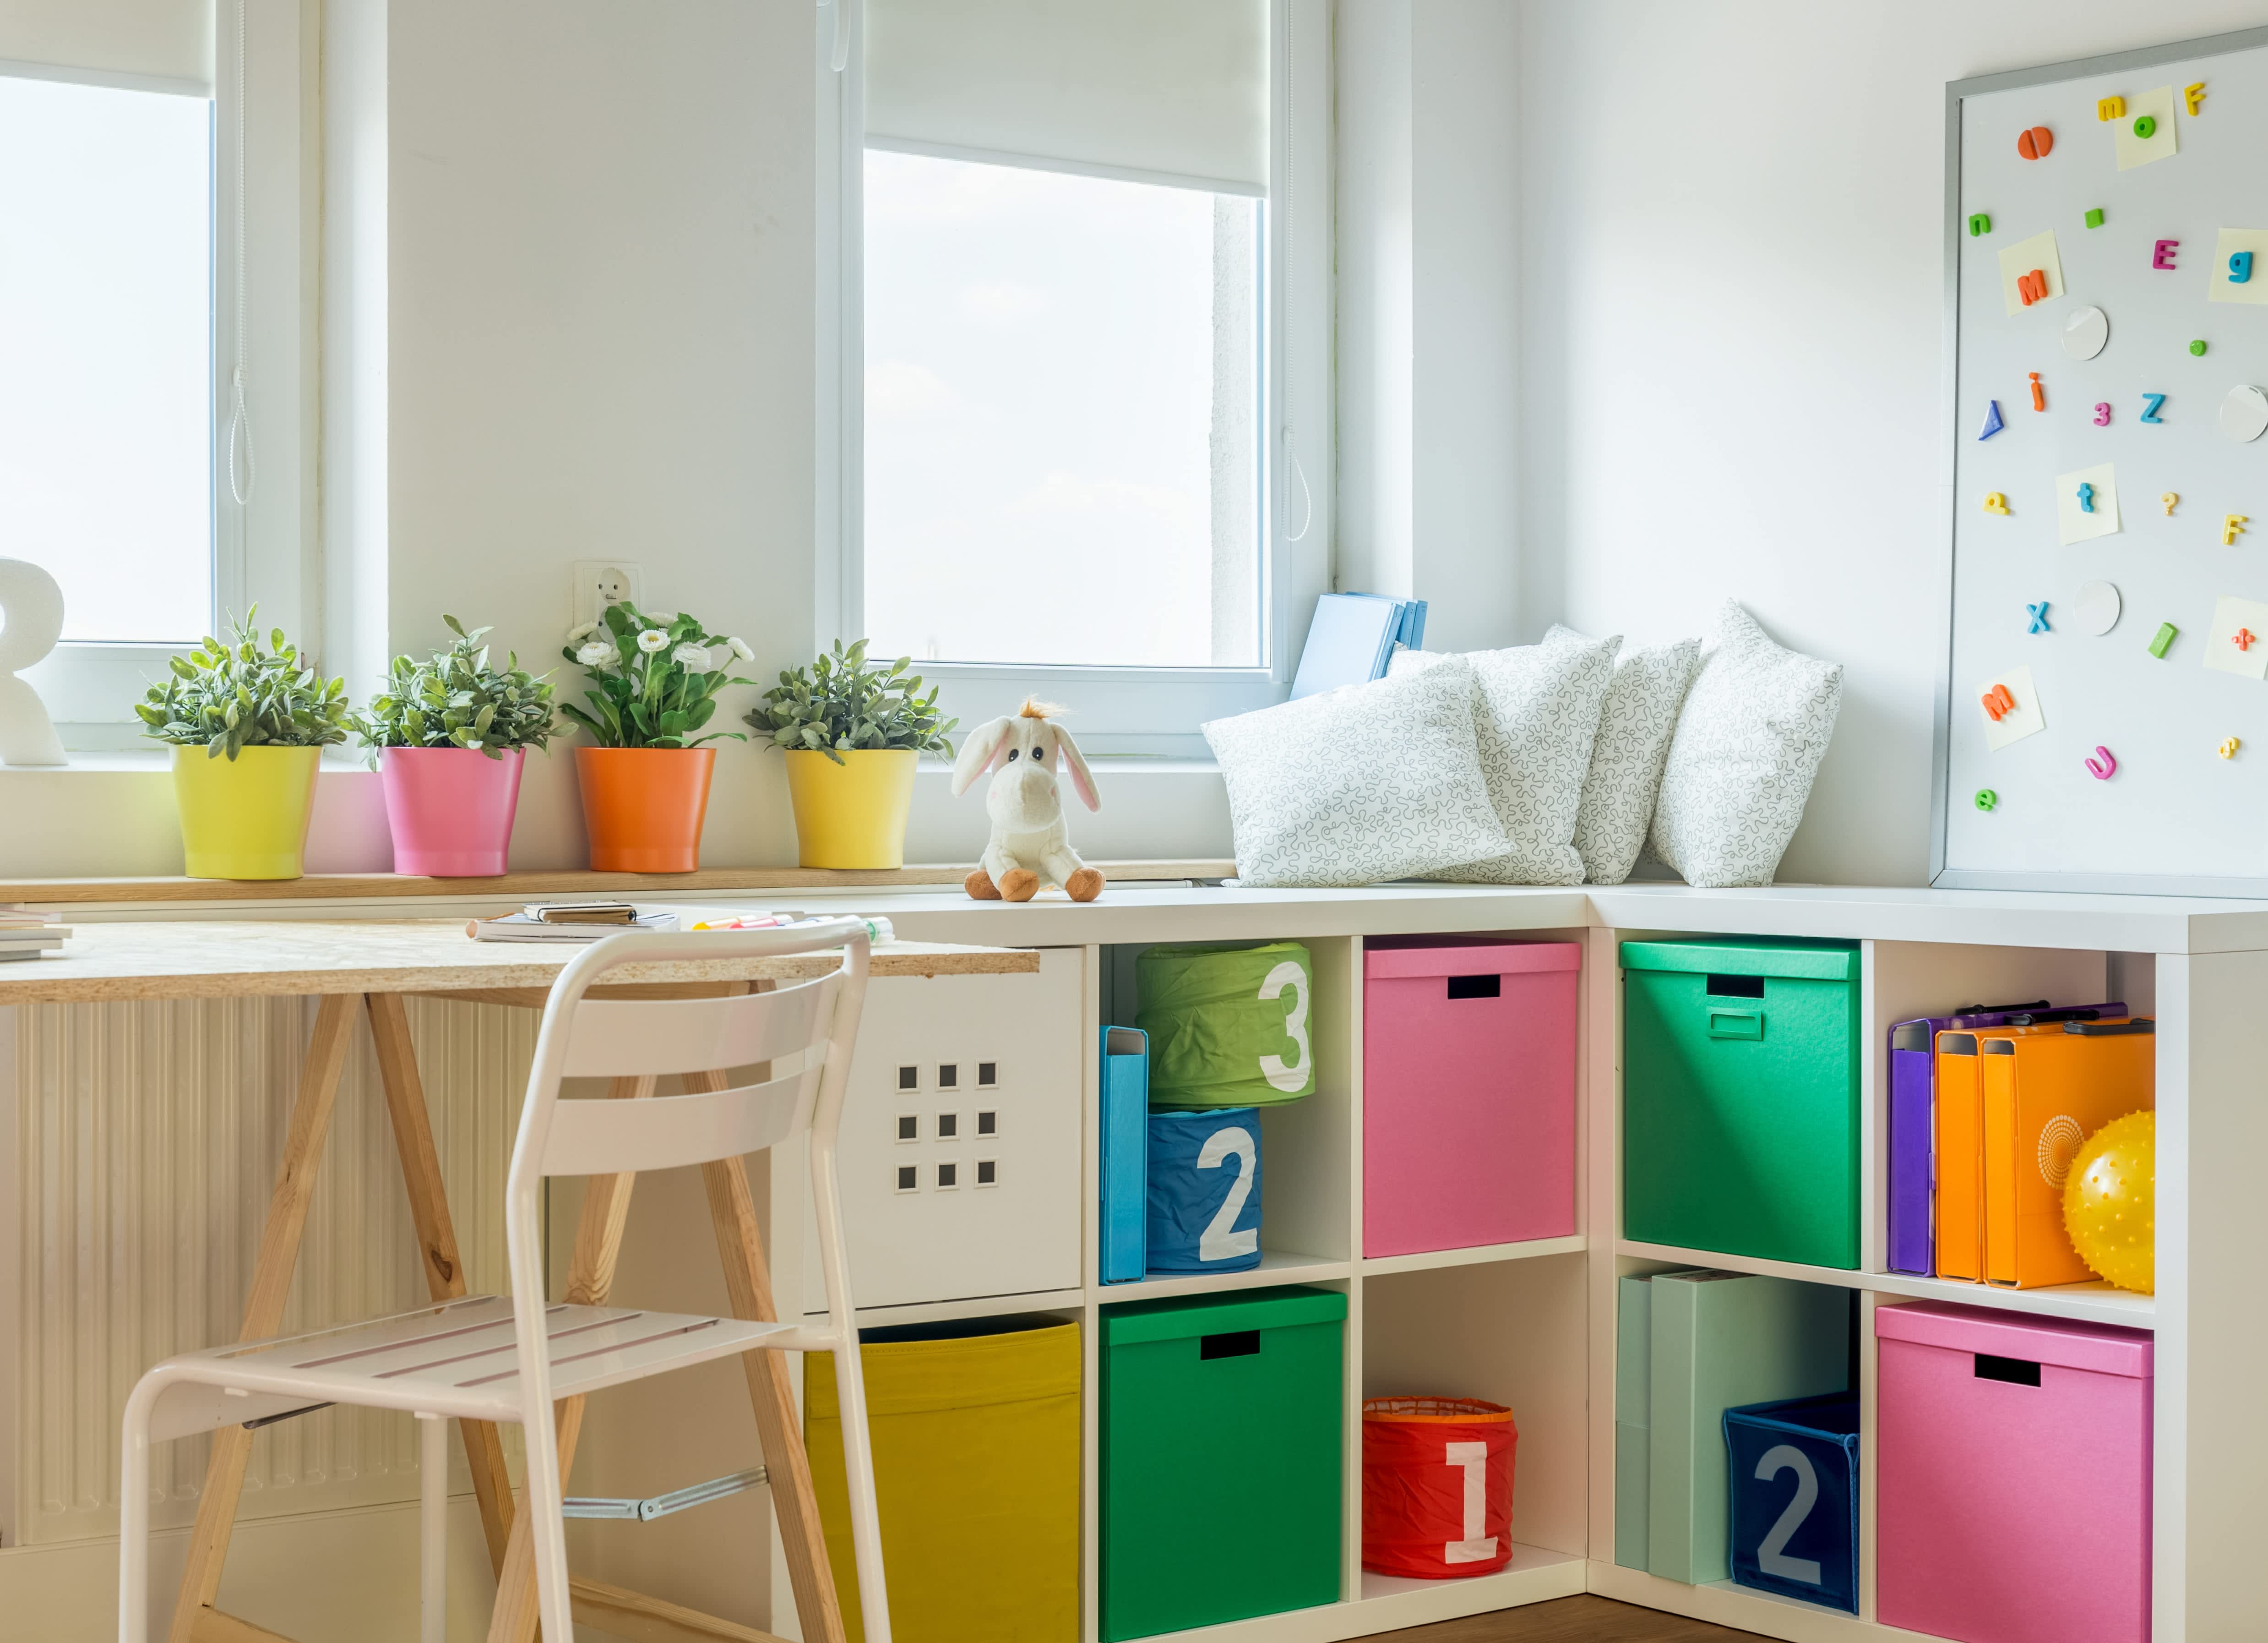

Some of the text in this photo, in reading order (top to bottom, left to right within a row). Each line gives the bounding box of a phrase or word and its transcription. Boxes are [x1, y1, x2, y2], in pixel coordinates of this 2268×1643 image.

[2184, 82, 2206, 116] F
[1969, 214, 1991, 236] n
[2153, 240, 2179, 269] E
[2018, 269, 2048, 306] M
[2094, 402, 2110, 426] 3
[2223, 514, 2248, 545] F
[1981, 684, 2015, 721] M
[1974, 789, 1996, 811] e
[1258, 961, 1311, 1092] 3
[1197, 1126, 1258, 1262] 2
[1445, 1441, 1498, 1563] 1
[1754, 1445, 1821, 1585] 2
